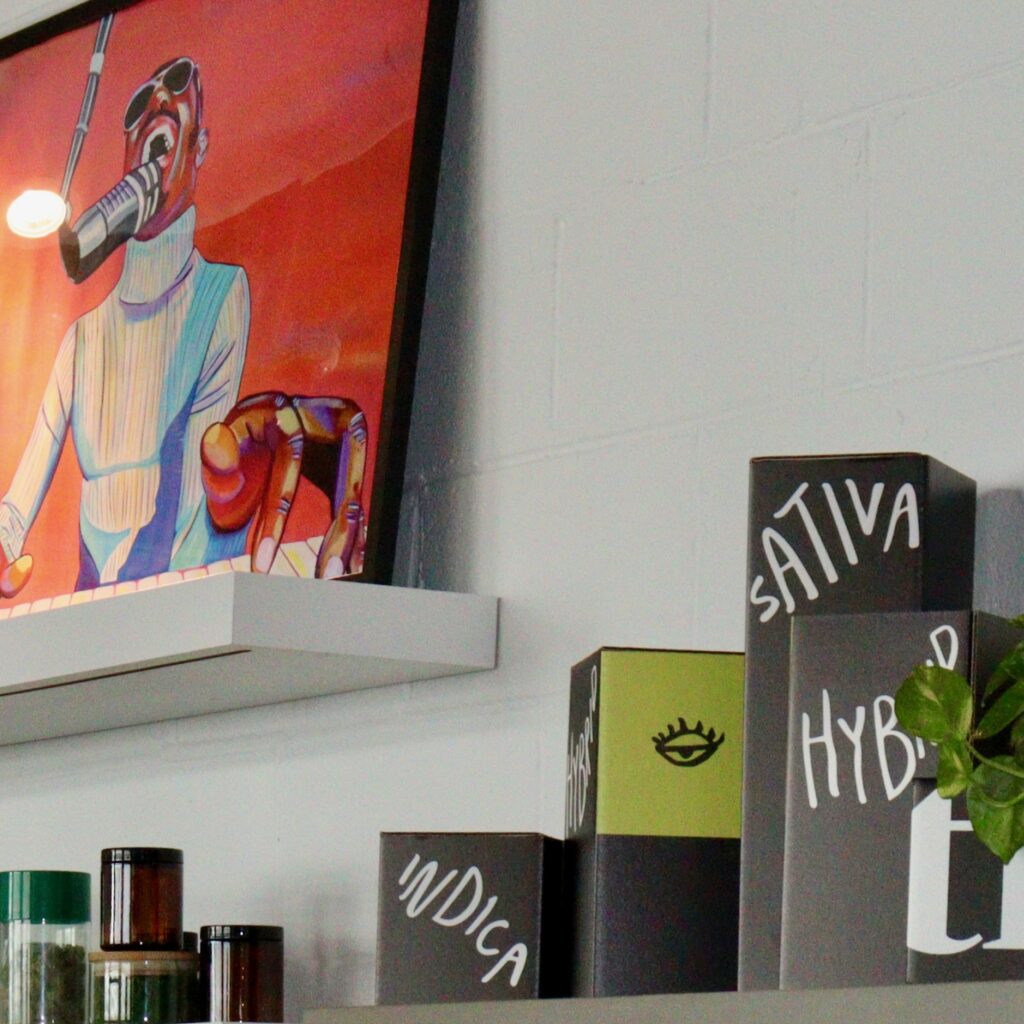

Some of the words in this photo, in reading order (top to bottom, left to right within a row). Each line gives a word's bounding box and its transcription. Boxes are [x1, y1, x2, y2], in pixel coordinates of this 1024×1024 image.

[749, 479, 920, 623] SATIVA
[802, 624, 959, 809] HYBD
[399, 854, 529, 987] INDICA
